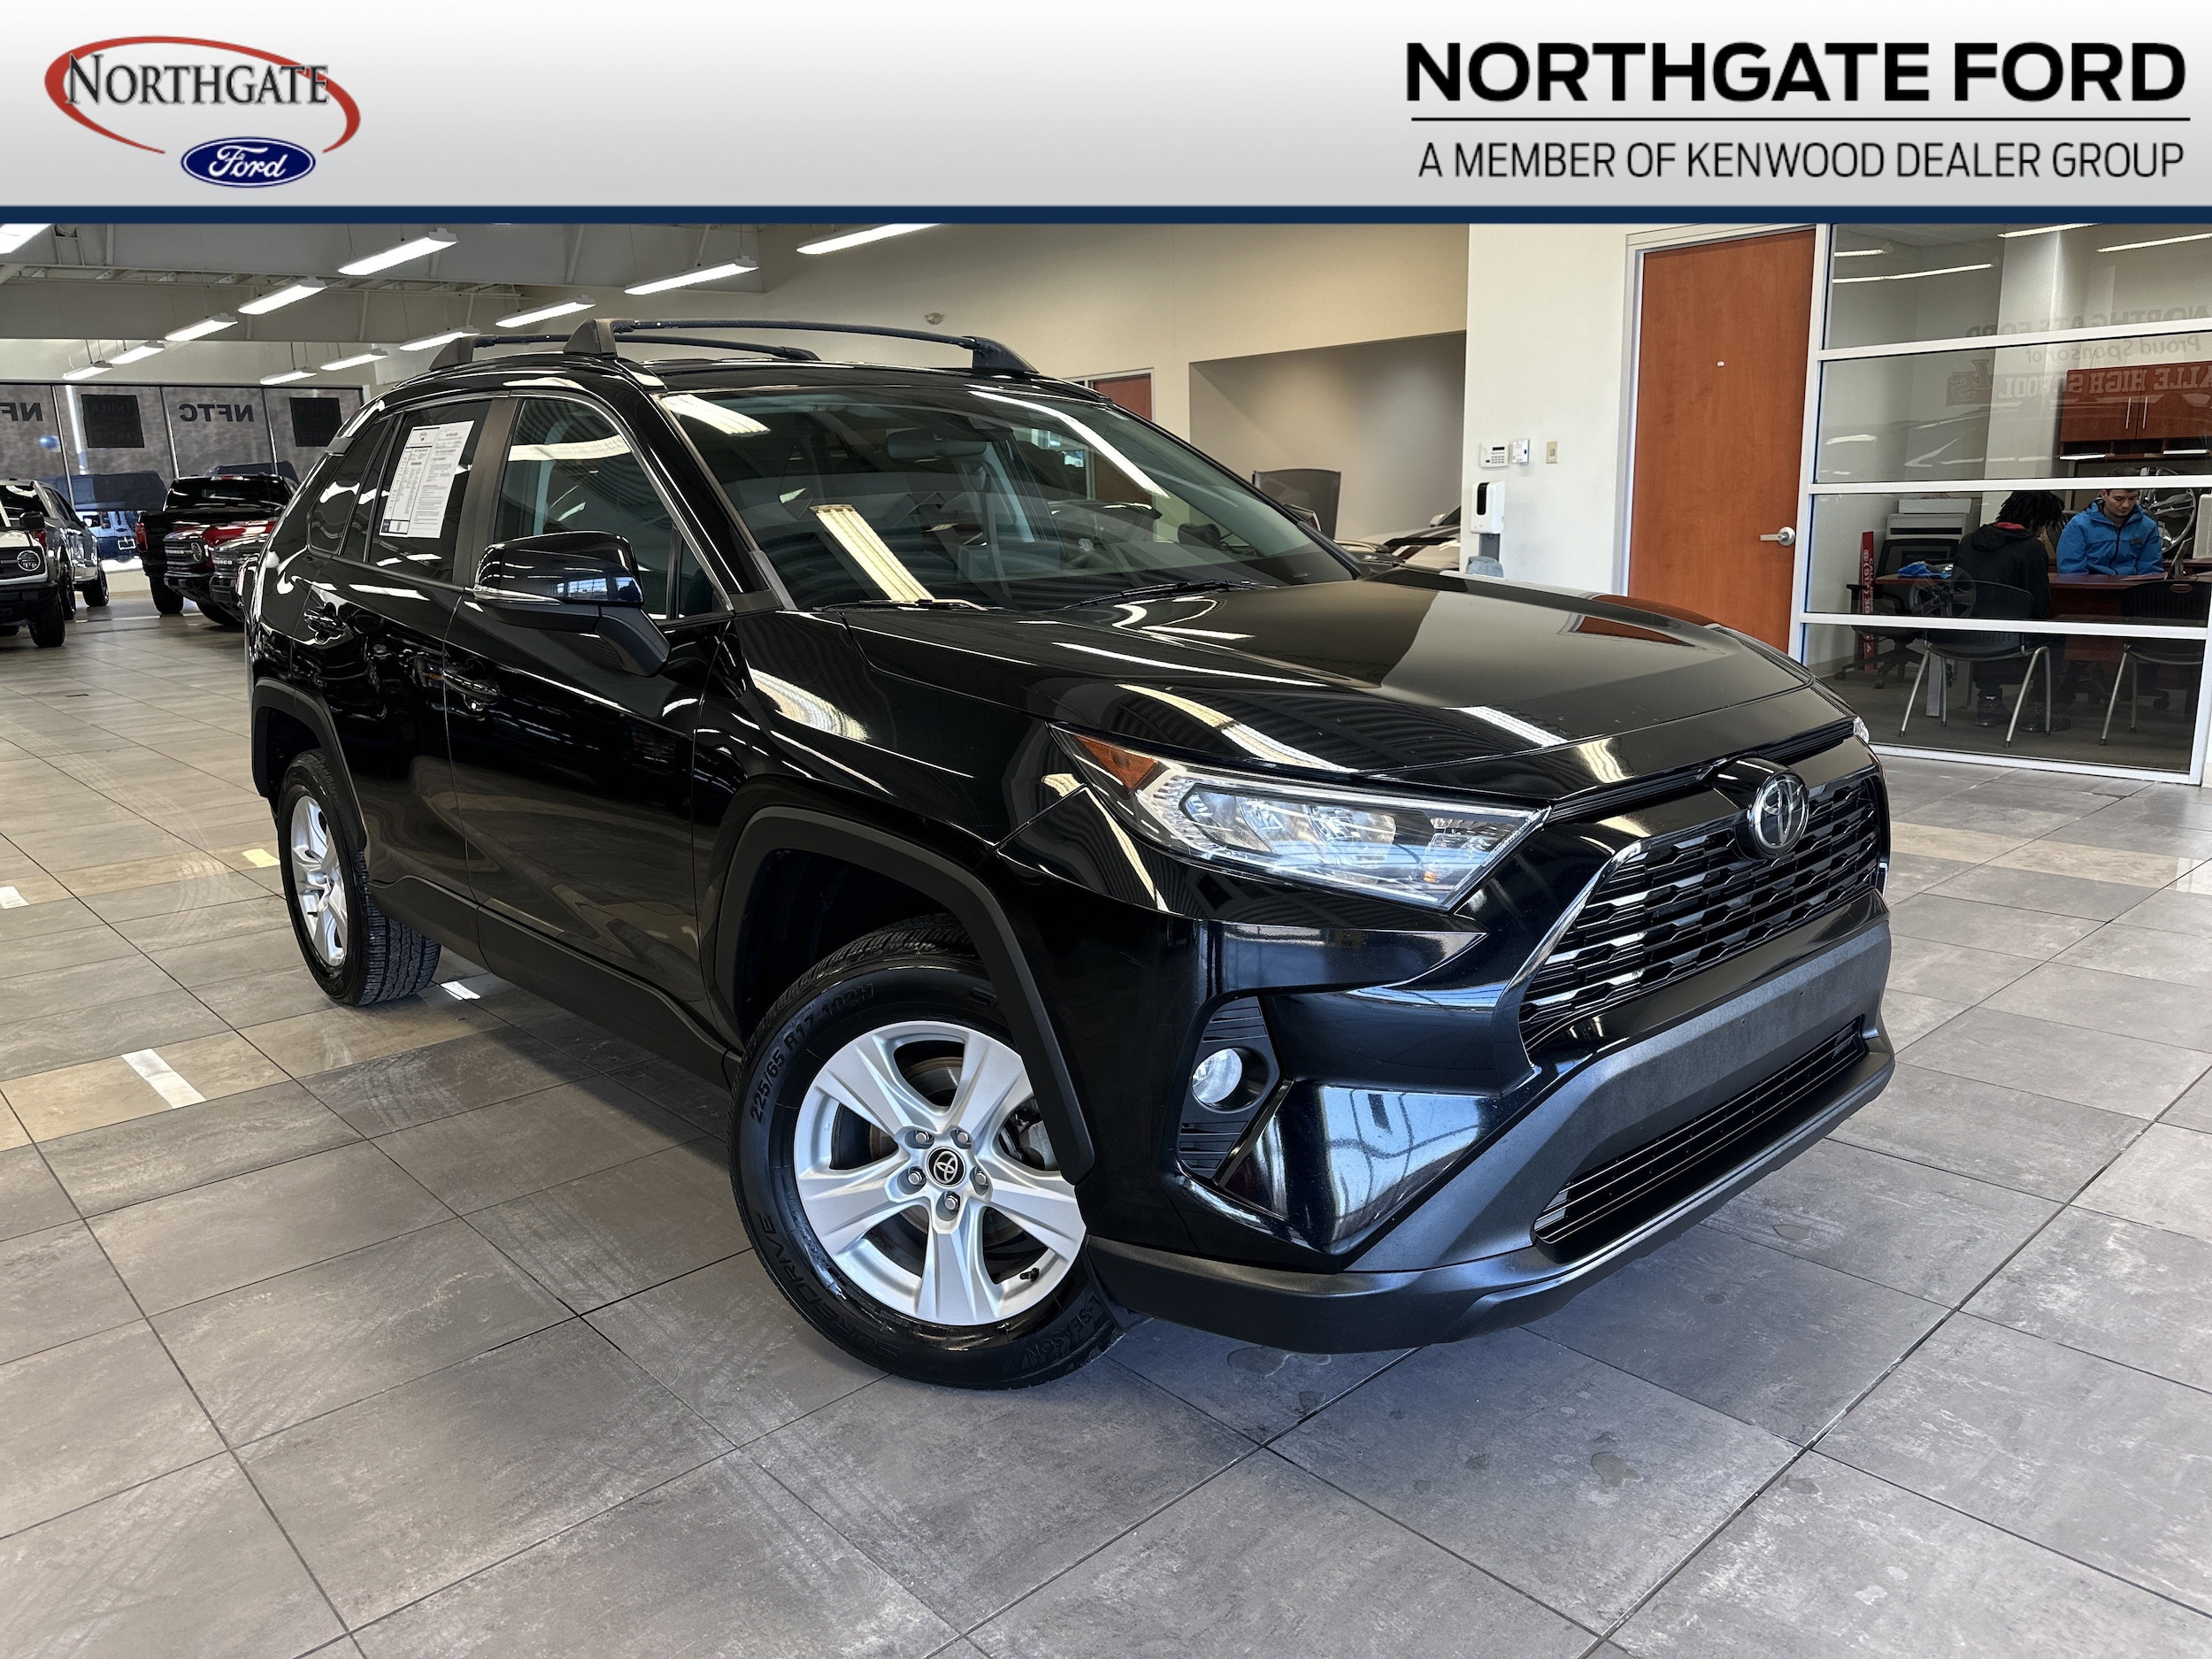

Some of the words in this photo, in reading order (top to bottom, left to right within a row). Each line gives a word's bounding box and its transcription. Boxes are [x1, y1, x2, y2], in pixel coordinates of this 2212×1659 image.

[749, 1048, 786, 1124] 225/65
[783, 1010, 817, 1052] R17
[821, 983, 874, 1016] 102H
